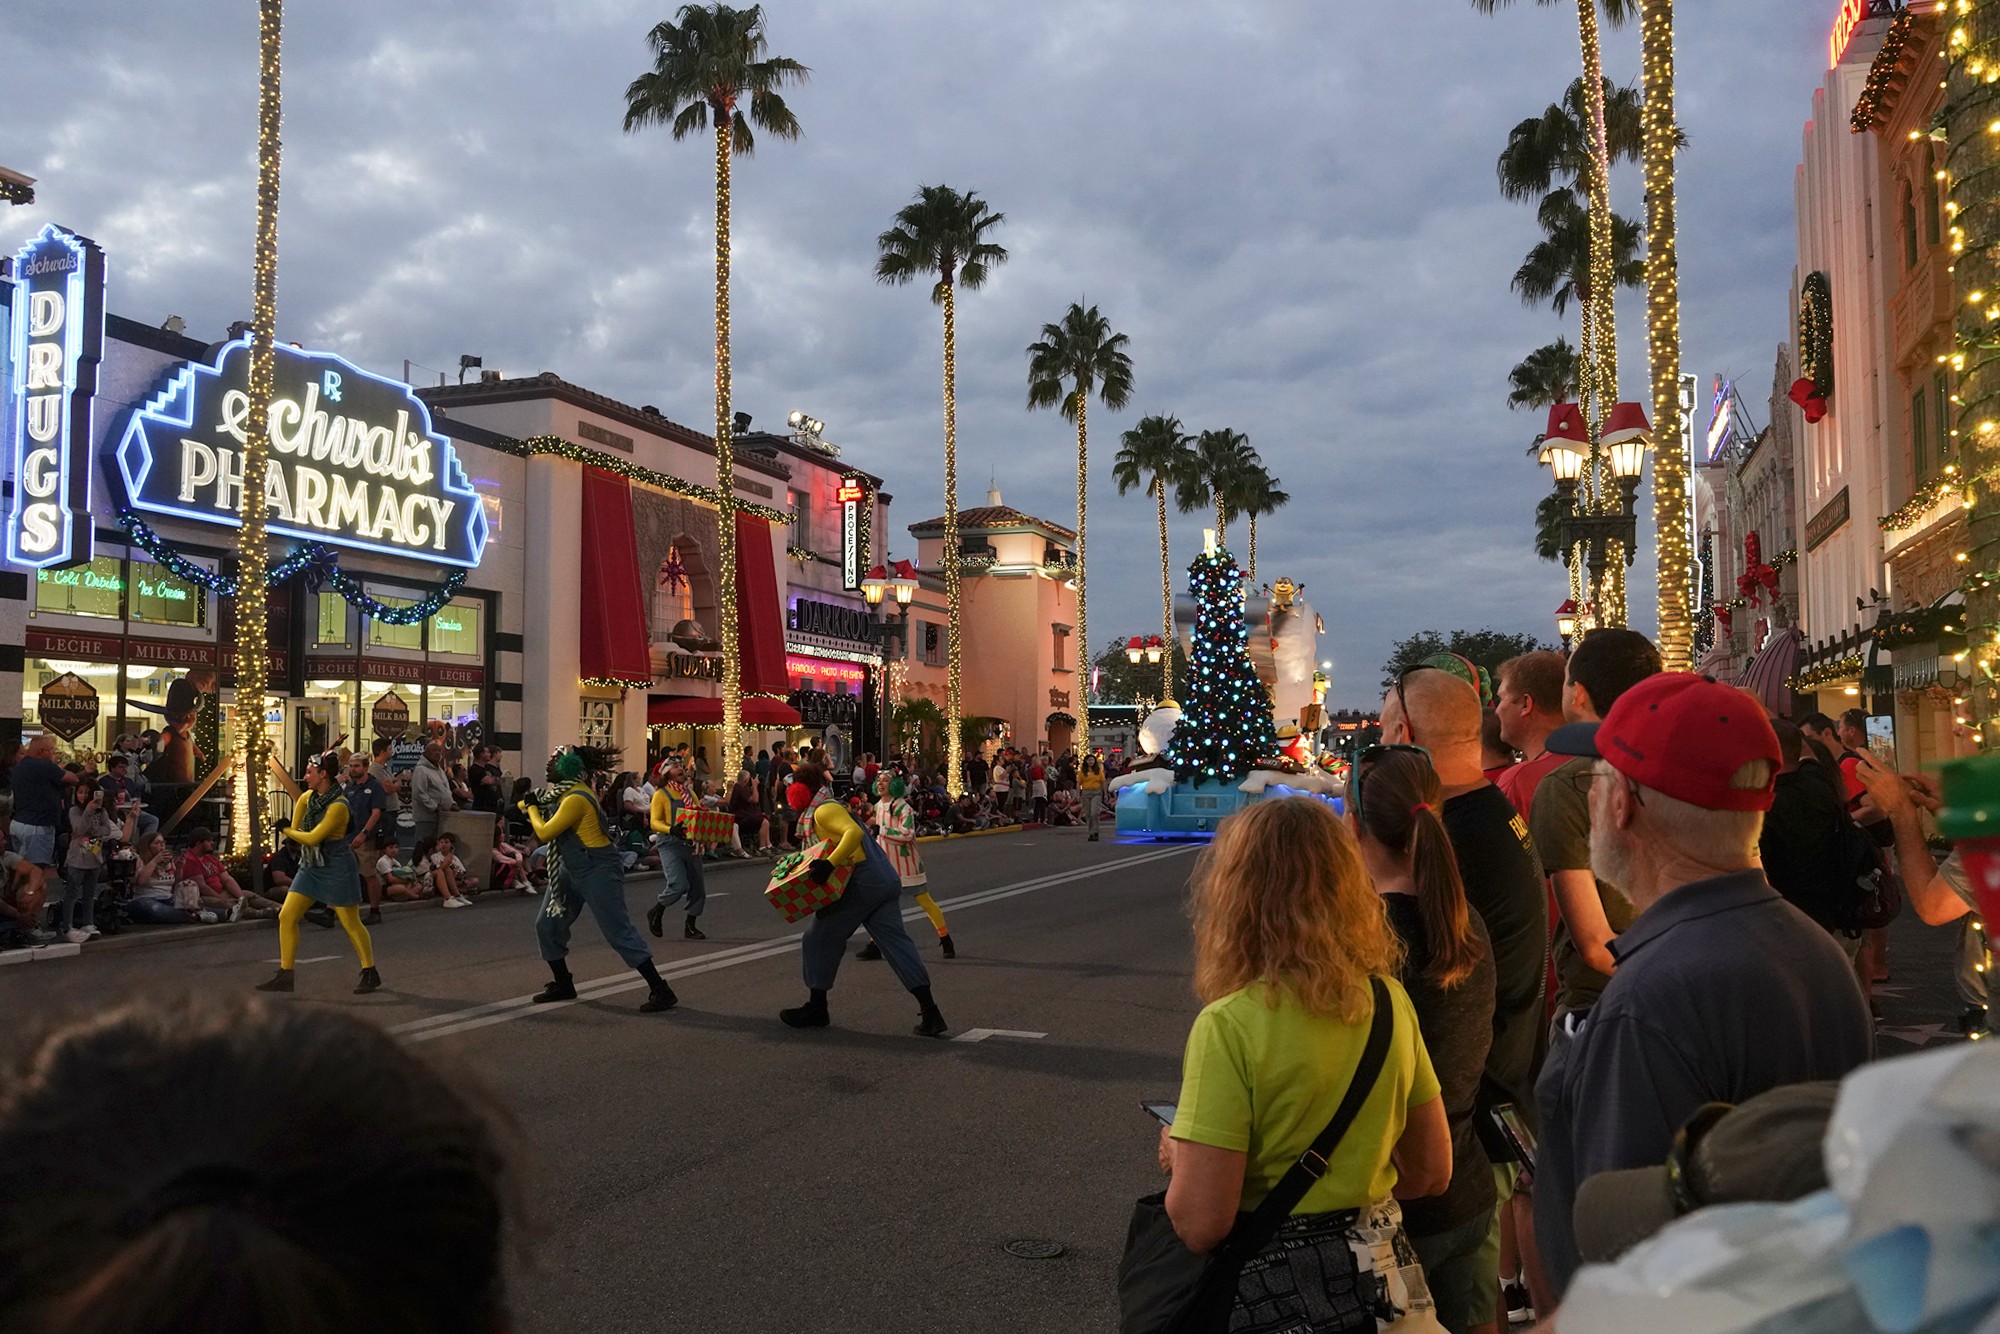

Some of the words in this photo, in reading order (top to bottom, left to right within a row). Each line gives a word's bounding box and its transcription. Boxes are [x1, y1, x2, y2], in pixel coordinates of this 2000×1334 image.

[25, 253, 78, 277] Schwab's
[20, 290, 66, 552] DRUGS
[215, 382, 434, 485] Schwab's
[178, 439, 456, 551] PHARMACY
[54, 570, 79, 586] Cold
[84, 571, 121, 591] Drinks
[138, 580, 154, 596] Ice
[157, 582, 187, 601] Cream
[800, 599, 872, 642] DARKROO
[45, 637, 103, 655] LECHE
[135, 645, 179, 662] MILK
[179, 649, 209, 663] BAR
[308, 664, 356, 674] LECHE
[367, 664, 396, 677] MILK
[398, 666, 420, 679] BAR
[440, 670, 473, 682] LECHE
[791, 663, 816, 675] FAMOUS
[821, 666, 838, 677] PHOTO
[41, 699, 73, 710] MILK
[74, 701, 98, 711] BAR
[373, 711, 393, 721] MILK
[394, 712, 408, 722] BAR
